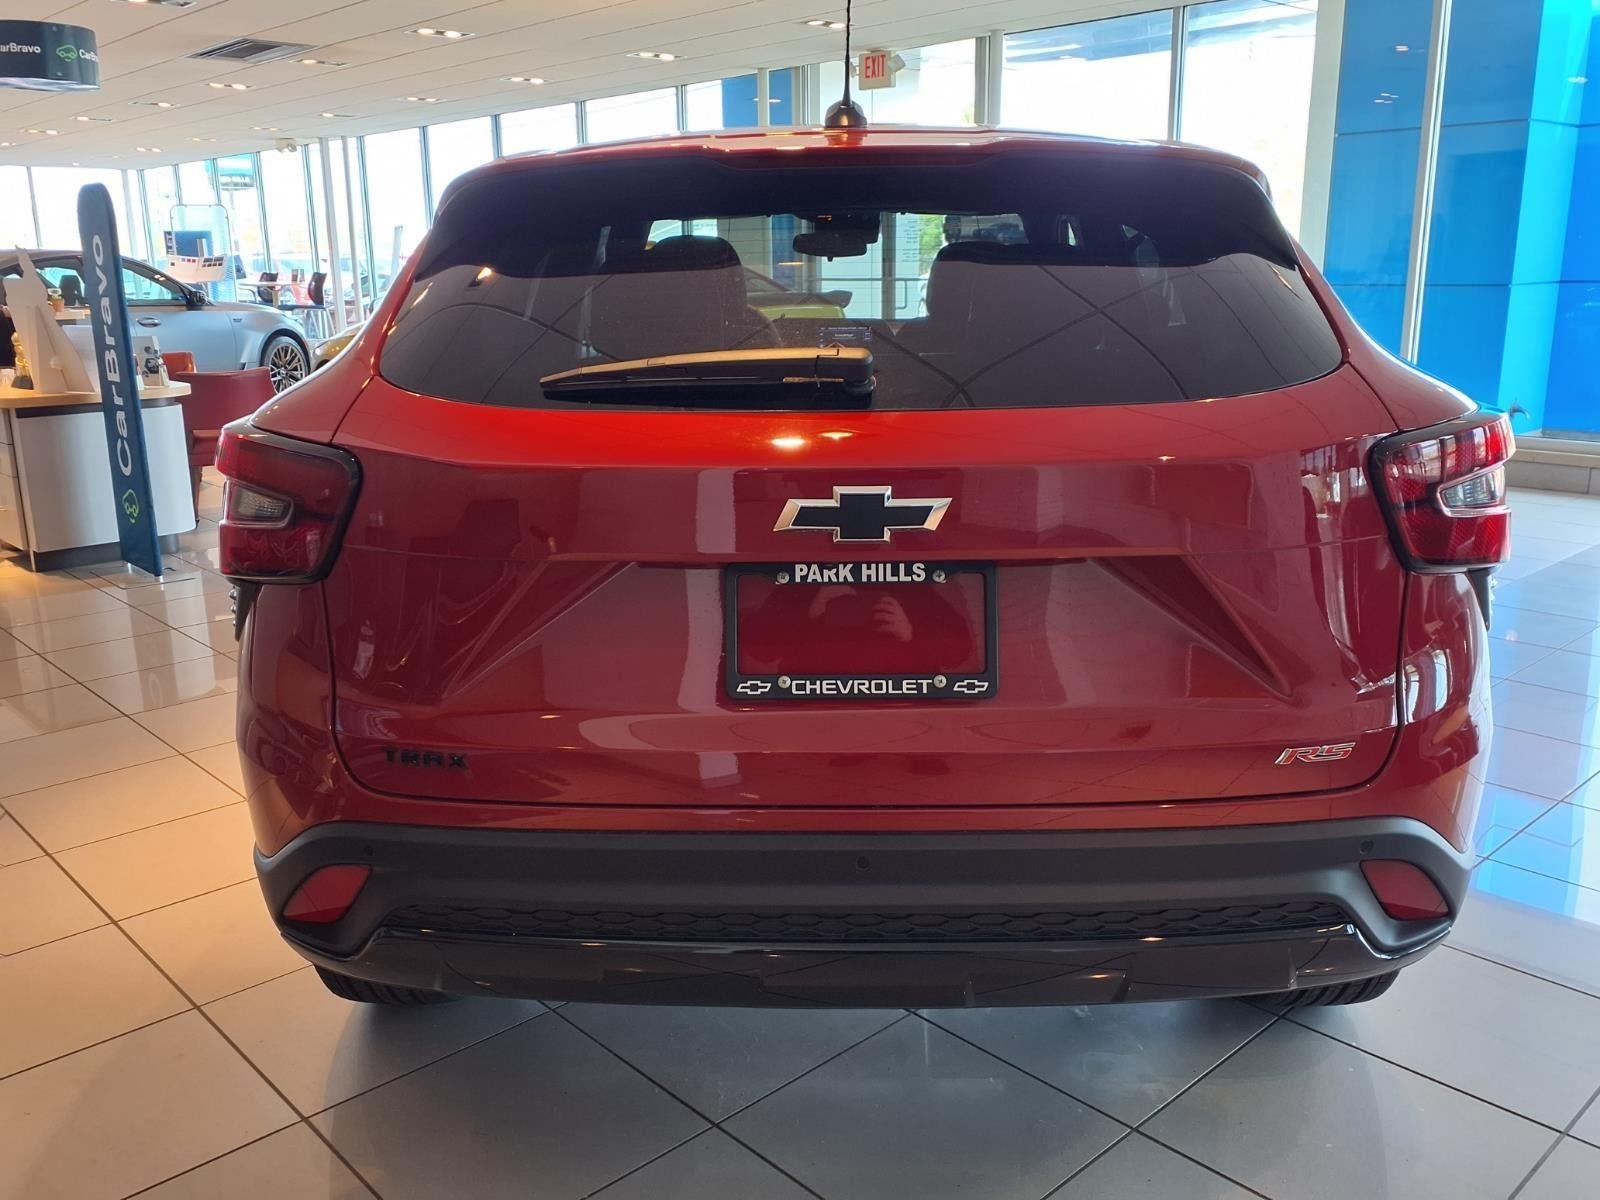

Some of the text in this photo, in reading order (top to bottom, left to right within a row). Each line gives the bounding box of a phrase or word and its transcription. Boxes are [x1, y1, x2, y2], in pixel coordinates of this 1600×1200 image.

[0, 42, 41, 54] arBravo
[864, 54, 886, 79] EXIT
[92, 234, 132, 477] CarBravo
[794, 563, 926, 583] PARK HILLS
[791, 679, 933, 695] CHEVROLET
[382, 746, 468, 769] TRAX
[1274, 742, 1356, 765] RS
